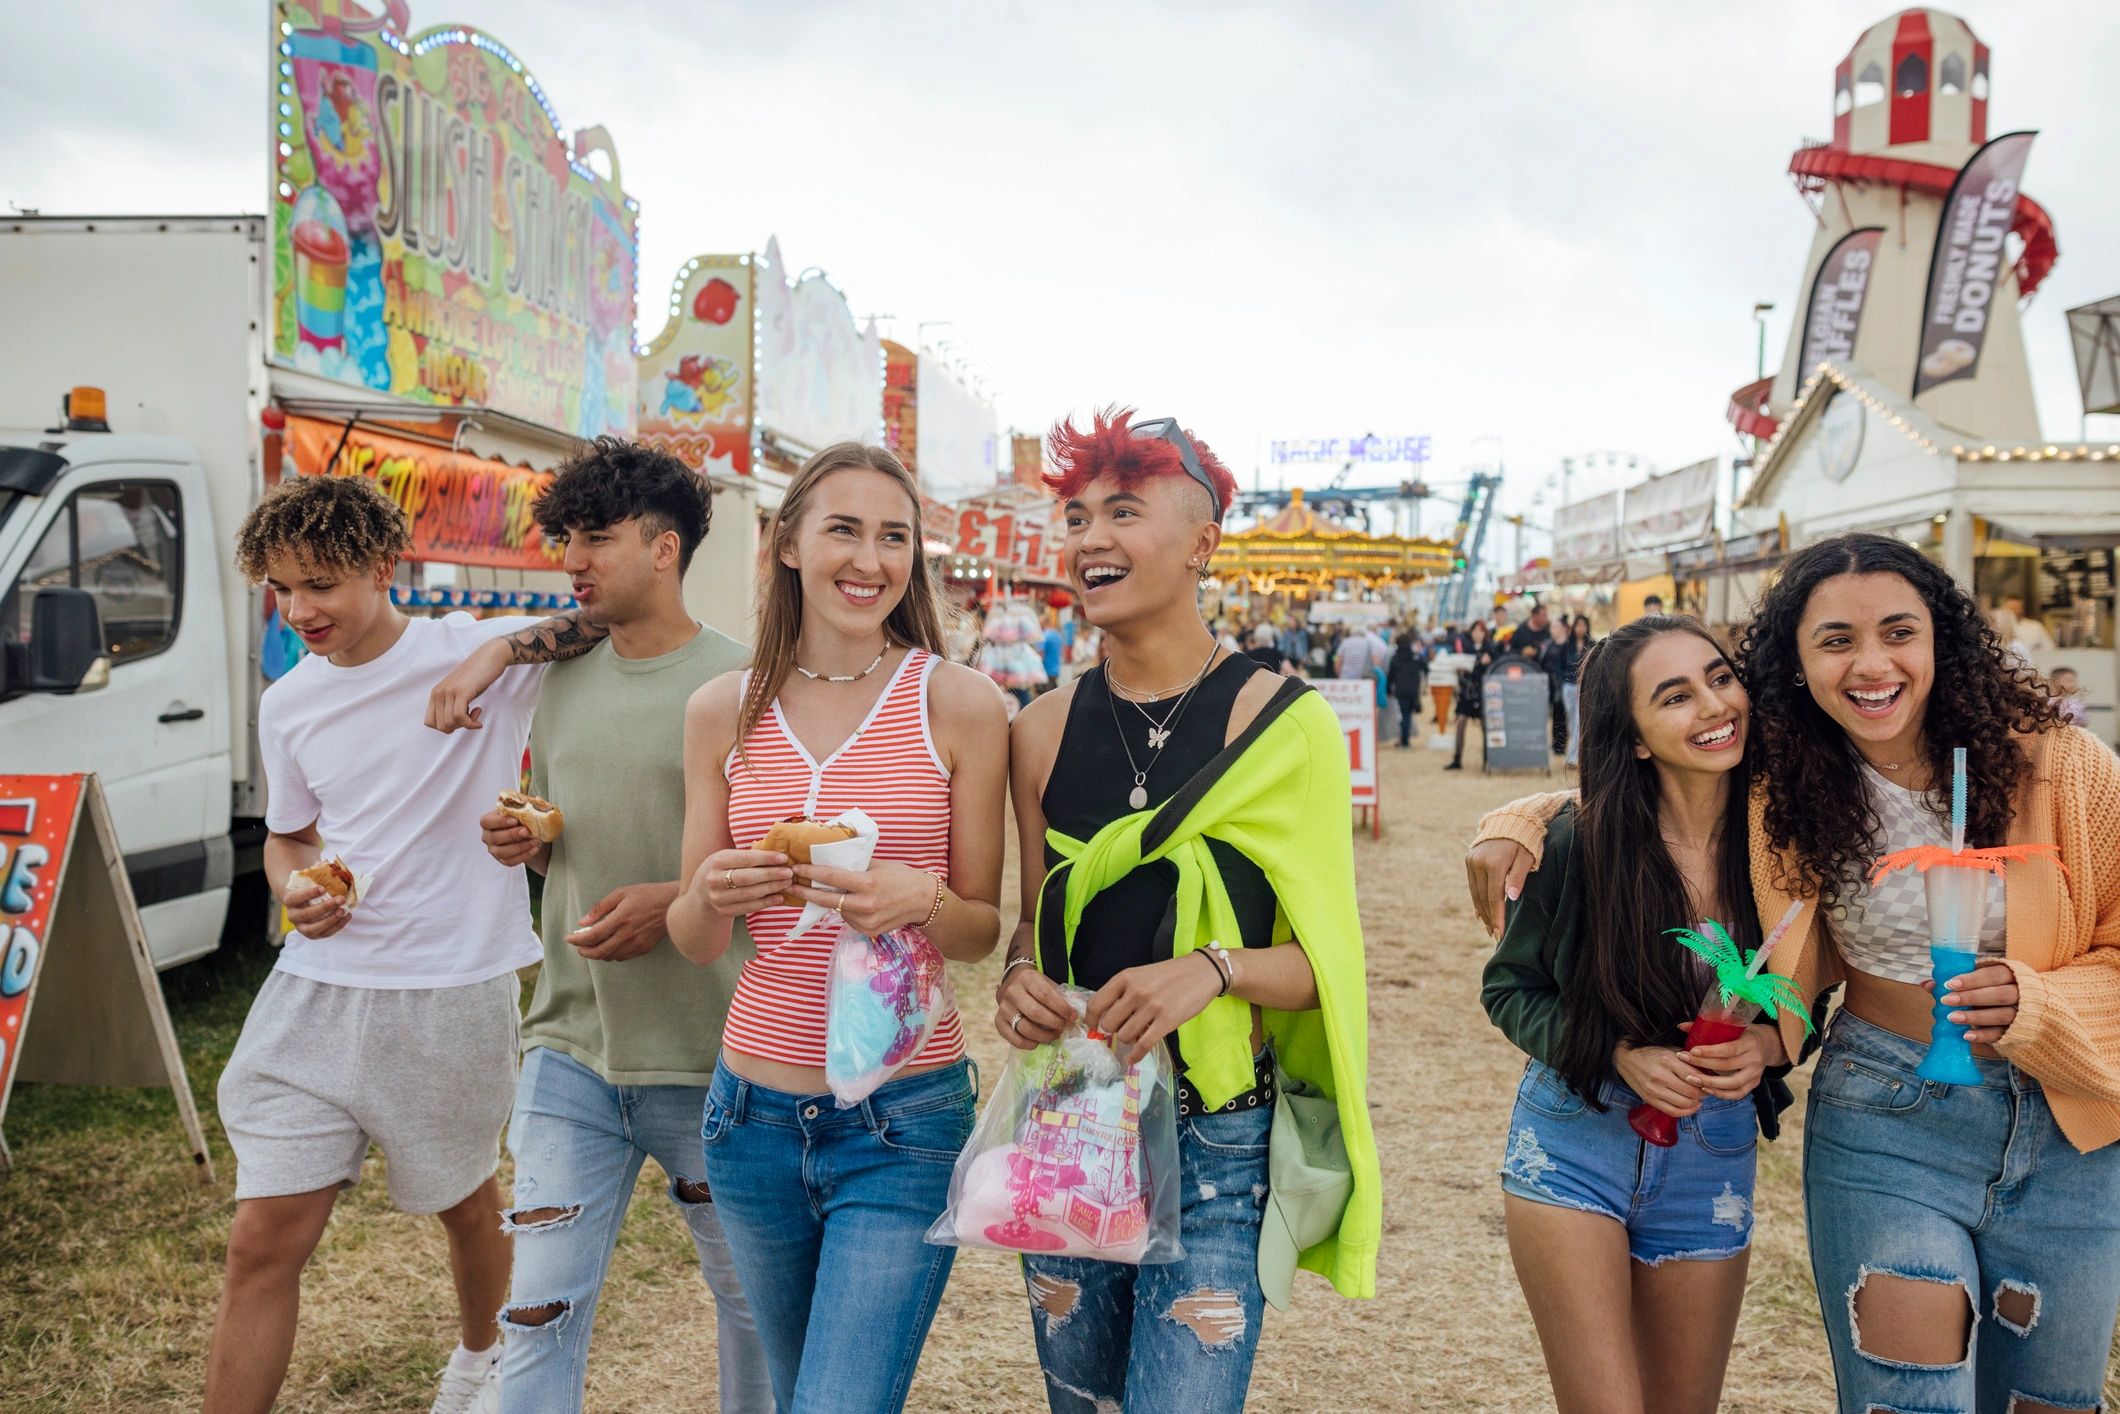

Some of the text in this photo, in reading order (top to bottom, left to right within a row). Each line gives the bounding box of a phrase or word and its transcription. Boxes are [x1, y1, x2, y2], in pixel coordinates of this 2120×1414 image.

[374, 70, 594, 333] SLUSH SHACK
[1934, 194, 1982, 325] FRESHLY MADE
[1953, 177, 2016, 333] DONUTS
[1826, 249, 1873, 361] AFFLES
[955, 509, 1015, 560] £1
[0, 842, 48, 913] E
[0, 922, 40, 997] D
[1069, 1211, 1095, 1232] FLOSS
[1073, 1201, 1100, 1224] CANDY
